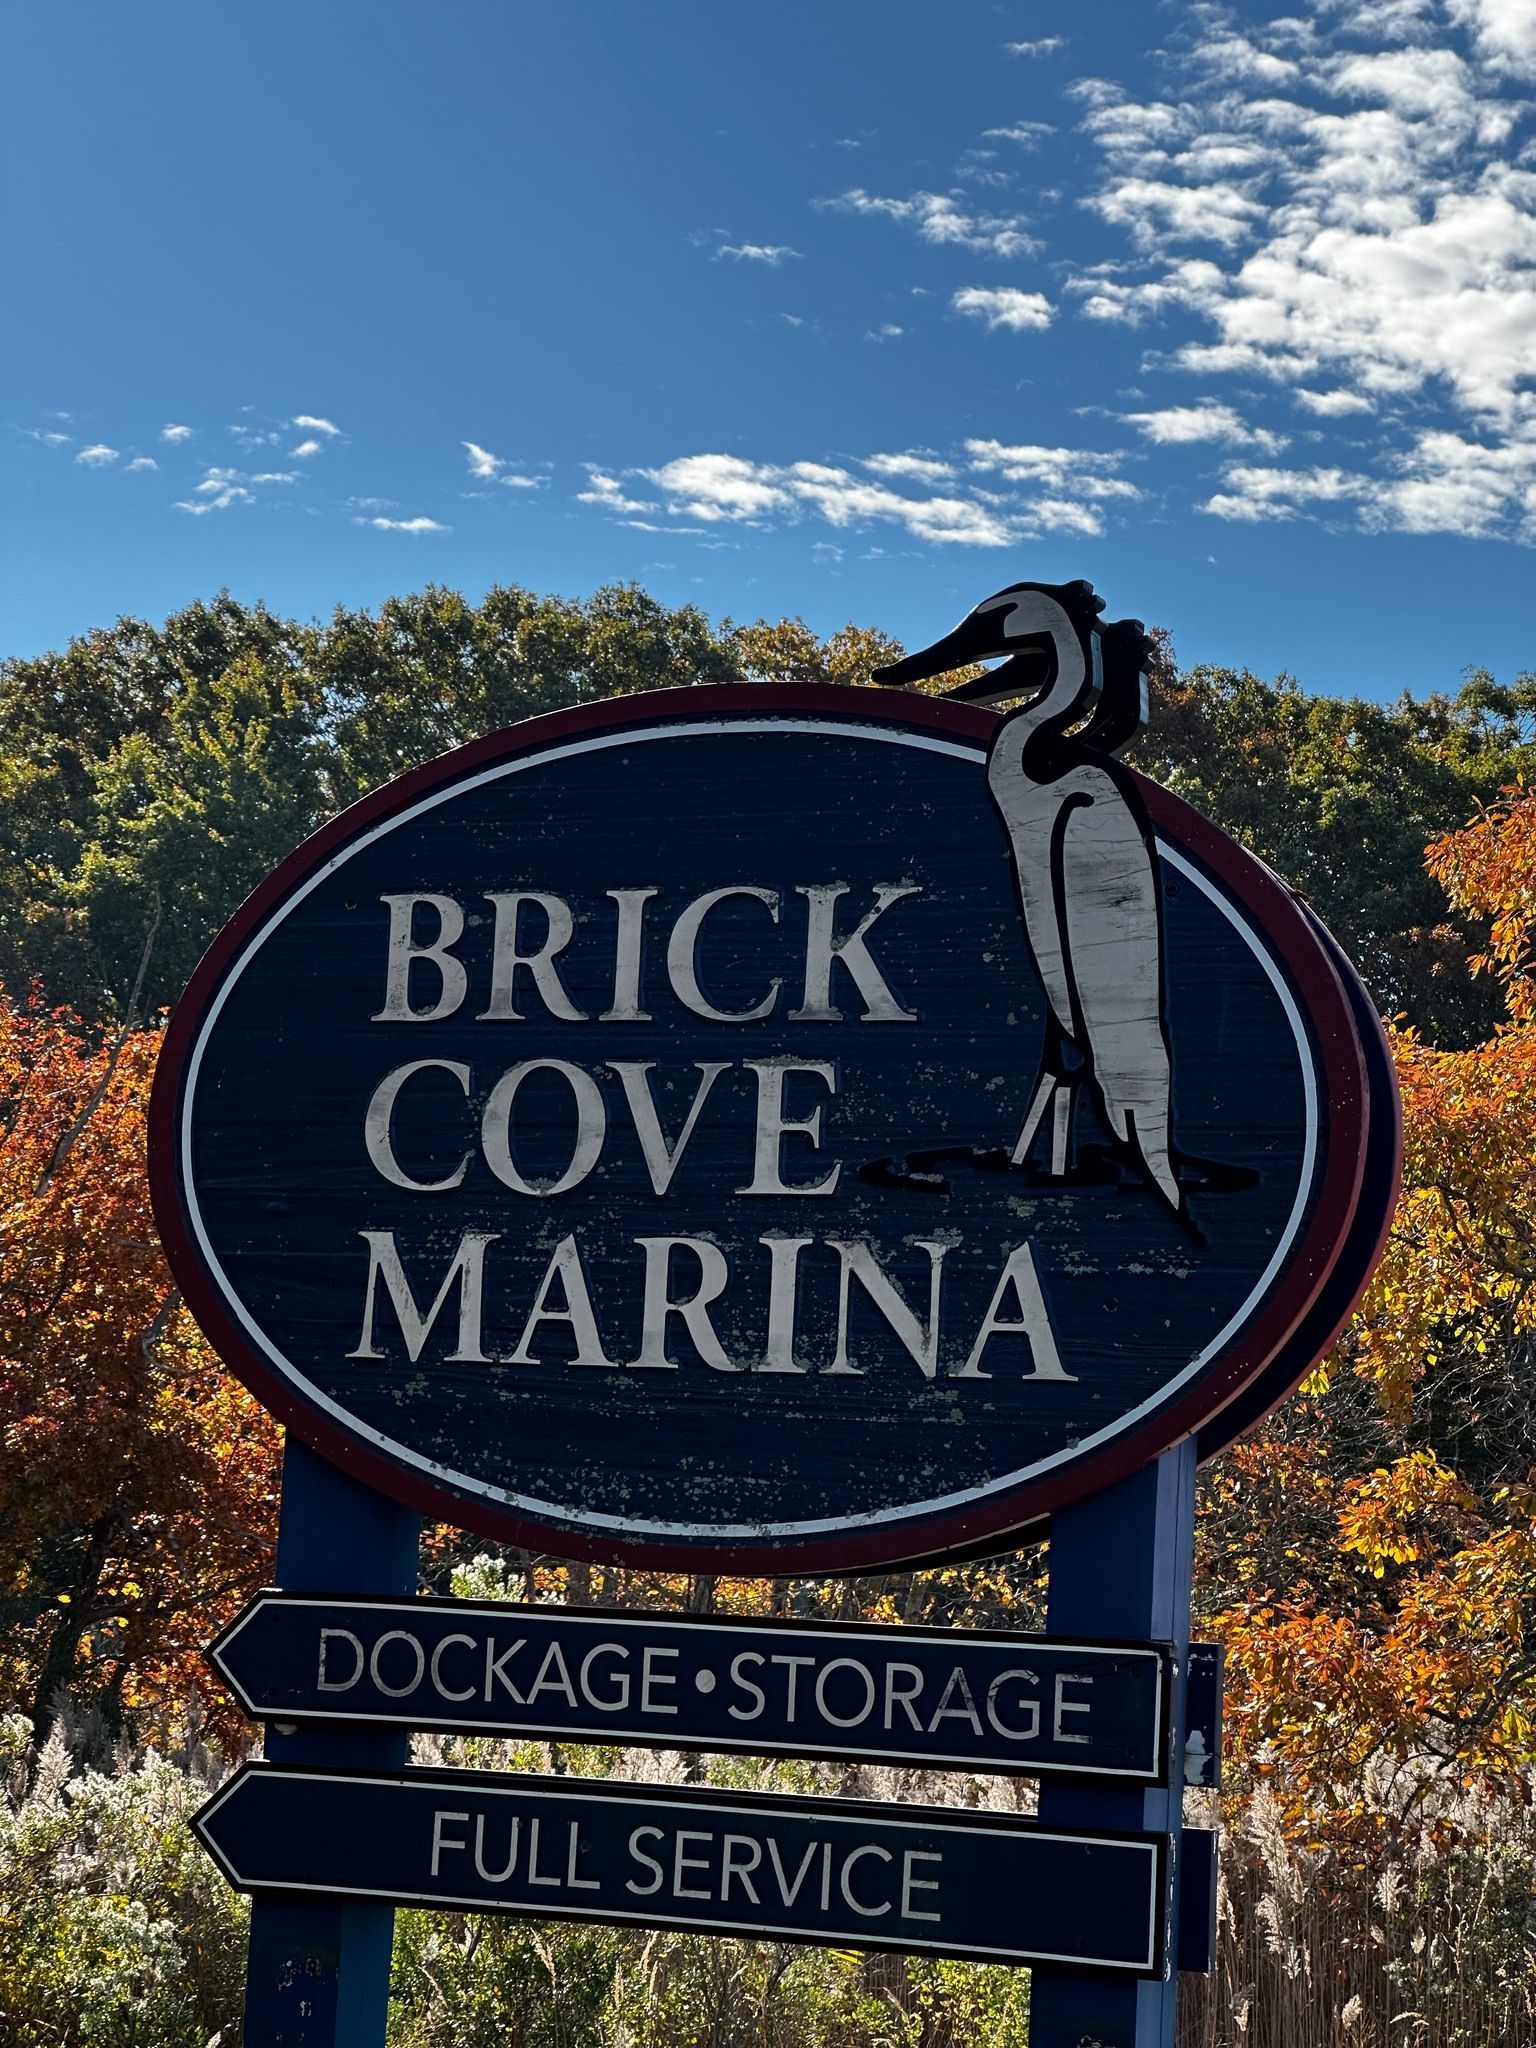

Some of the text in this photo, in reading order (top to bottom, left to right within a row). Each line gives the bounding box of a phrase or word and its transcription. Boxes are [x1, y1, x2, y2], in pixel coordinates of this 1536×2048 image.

[370, 886, 923, 1022] BRICK
[364, 1058, 842, 1197] COVE
[344, 1230, 1080, 1382] MARINA
[316, 1627, 1094, 1744] DOCKAGE STORAGE
[430, 1810, 942, 1922] FULL SERVICE
